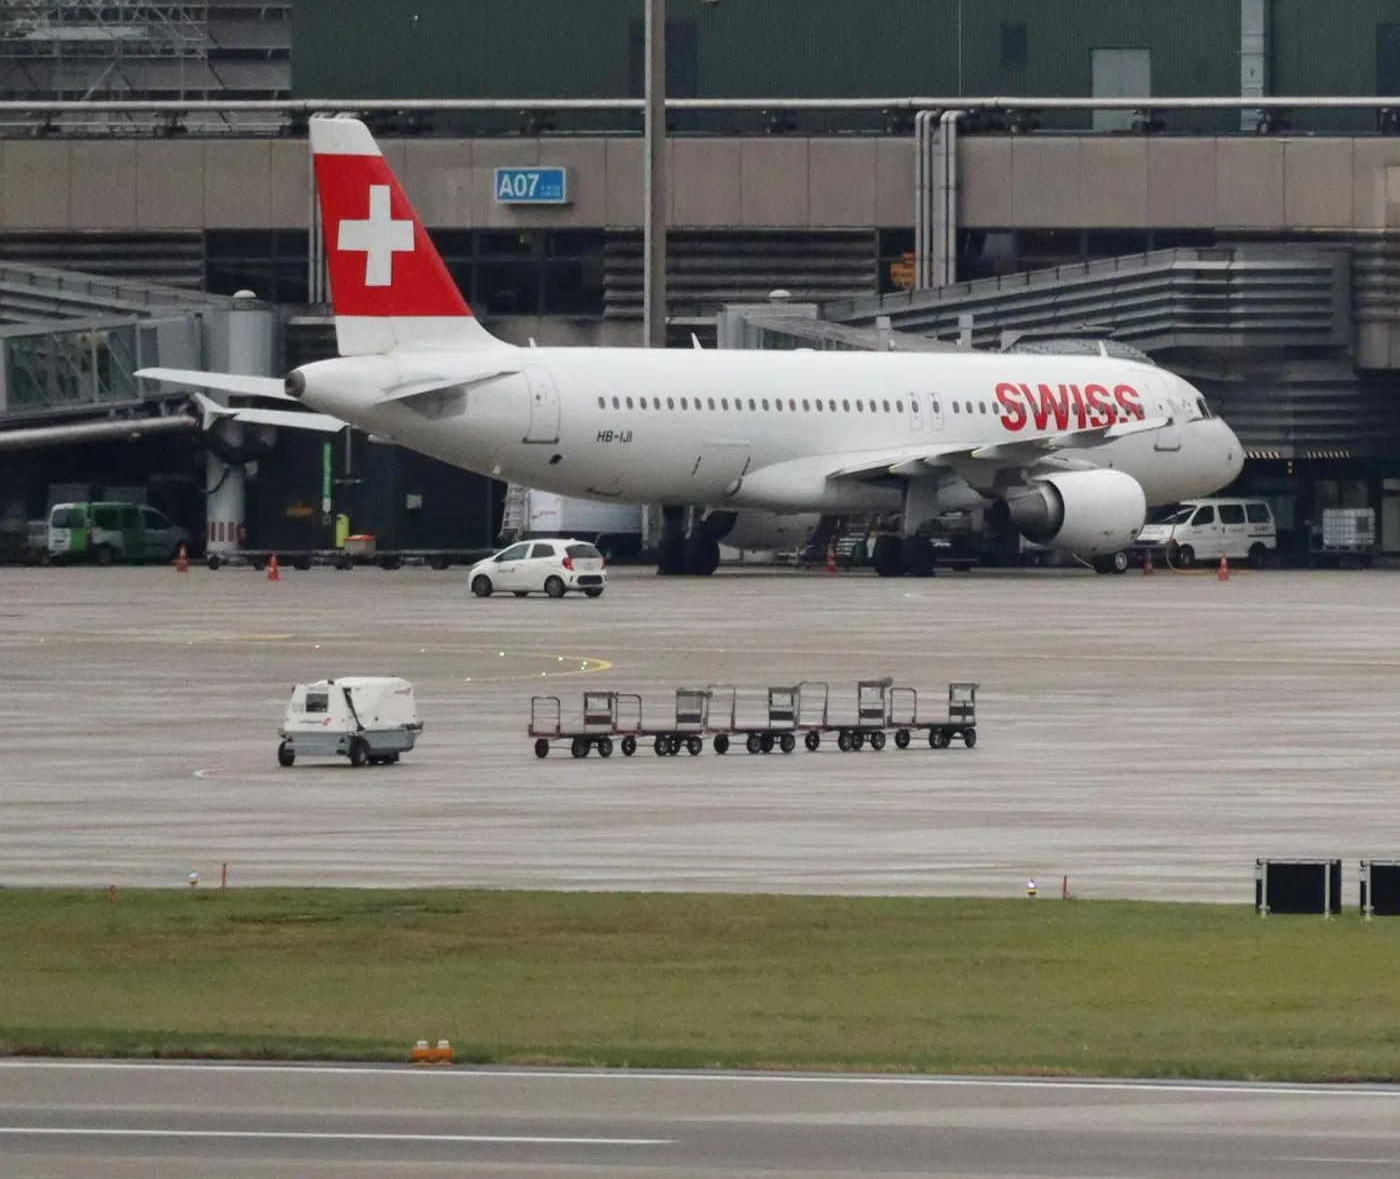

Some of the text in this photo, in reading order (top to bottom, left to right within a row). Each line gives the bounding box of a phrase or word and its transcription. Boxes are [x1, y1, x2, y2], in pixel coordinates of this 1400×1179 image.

[500, 174, 540, 197] A07
[995, 382, 1146, 432] SWISS
[596, 430, 633, 443] HB-IJI
